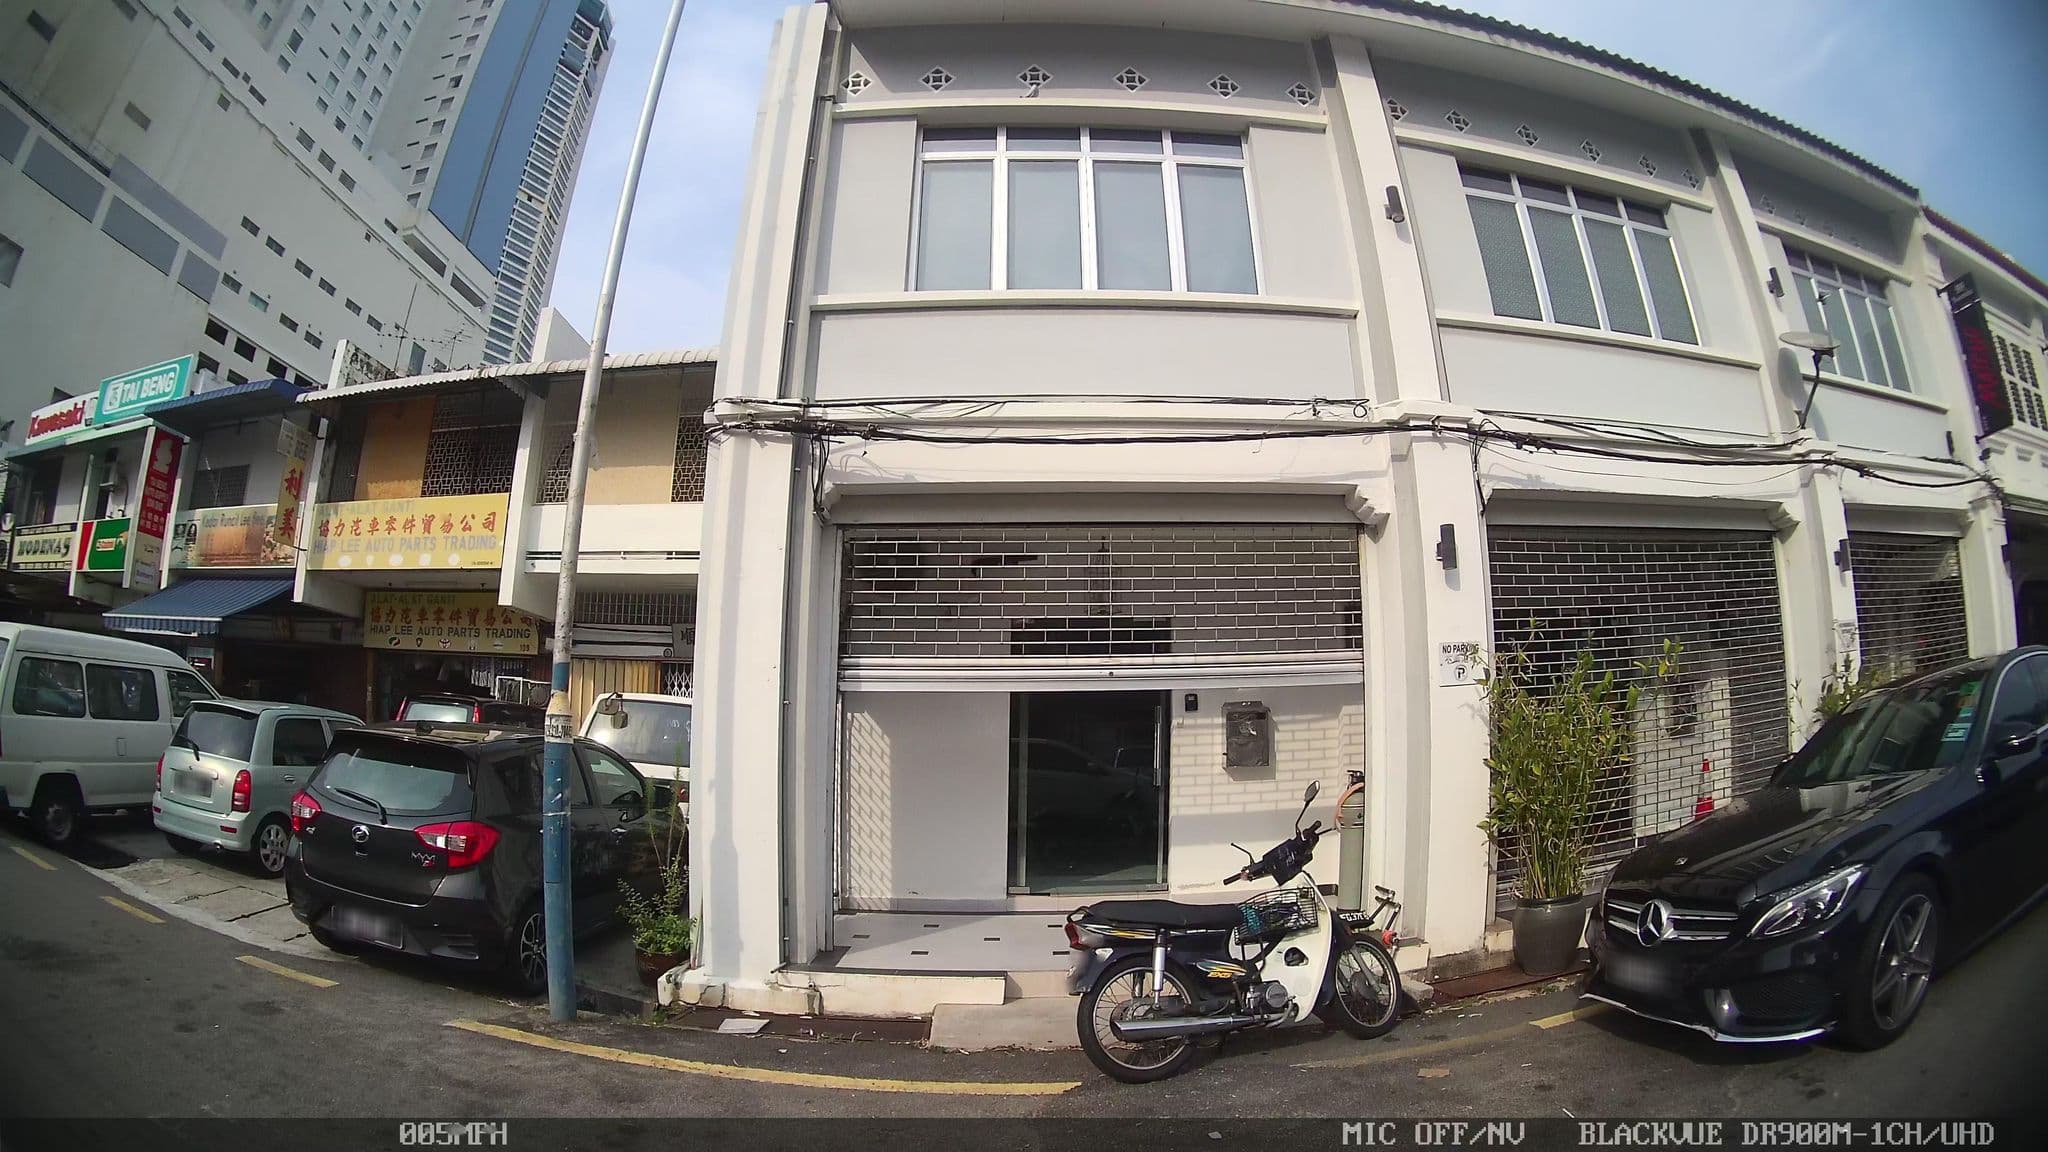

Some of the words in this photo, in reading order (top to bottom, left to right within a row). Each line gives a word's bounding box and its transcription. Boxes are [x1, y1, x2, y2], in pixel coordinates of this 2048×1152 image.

[122, 381, 141, 404] TAI
[141, 371, 175, 399] BENG
[341, 538, 361, 552] LEE
[366, 538, 395, 553] AUTO
[400, 536, 437, 552] PARTS
[443, 534, 498, 550] TRADING
[370, 624, 391, 636] HIAP
[395, 625, 413, 636] LEE
[417, 626, 443, 637] AUTO
[447, 627, 480, 638] PARTS
[485, 627, 531, 639] TRADING
[1442, 645, 1452, 653] NO
